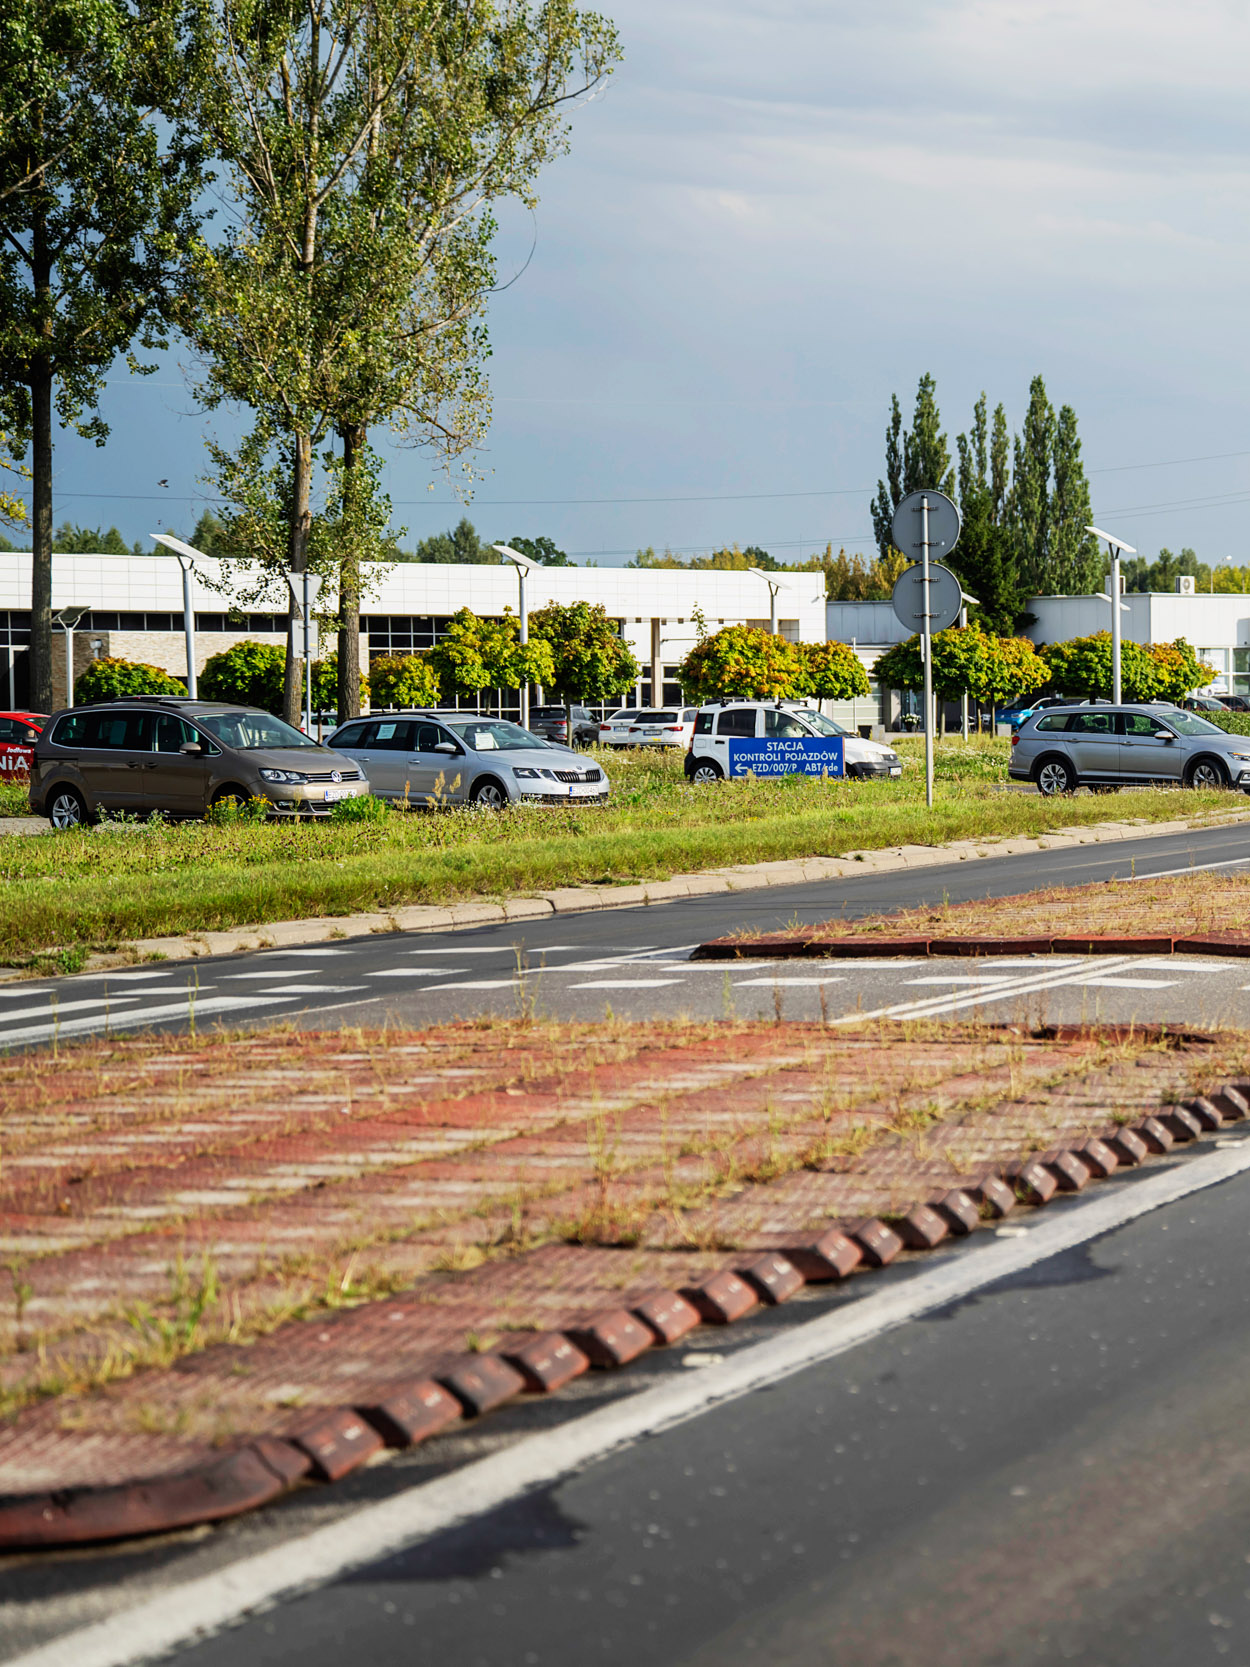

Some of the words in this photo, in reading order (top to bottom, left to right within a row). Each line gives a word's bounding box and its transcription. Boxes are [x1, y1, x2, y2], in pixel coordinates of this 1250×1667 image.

[766, 741, 805, 751] STACJA
[733, 753, 781, 762] KONTROLI
[784, 750, 838, 761] POJAZDÓW
[752, 763, 797, 773] EZD/007/P
